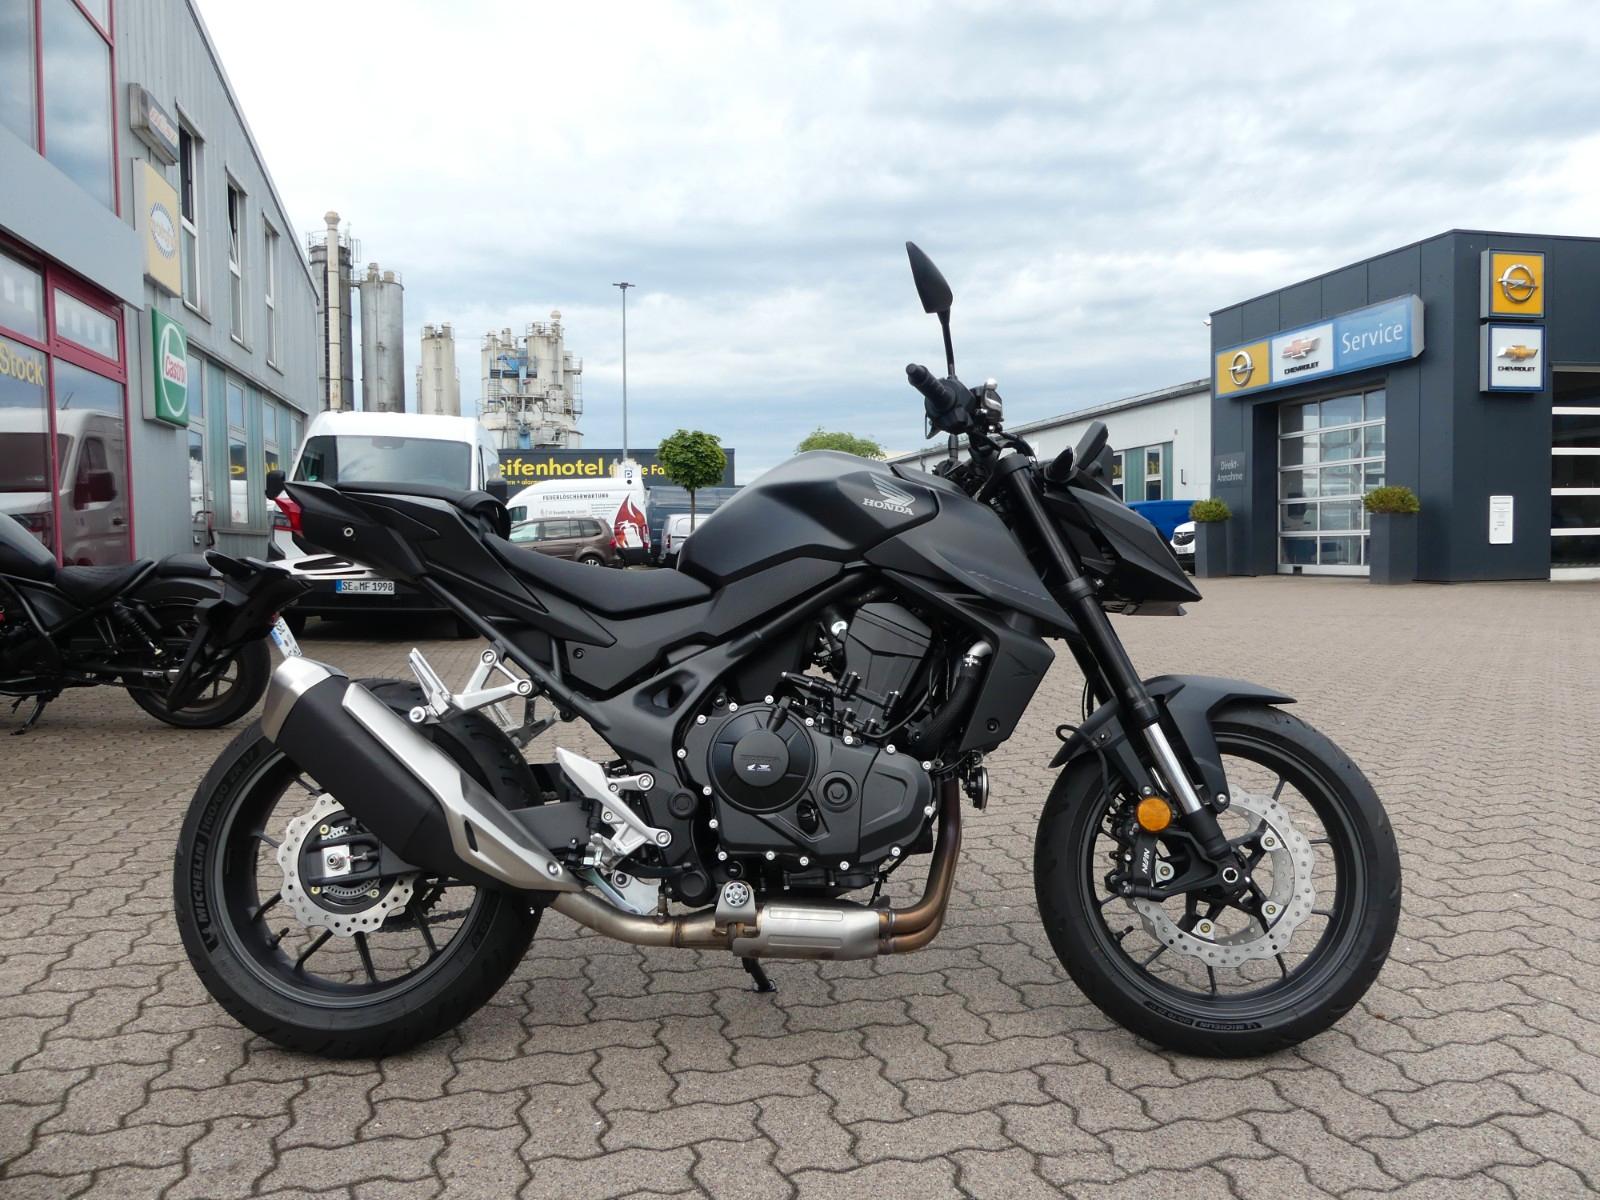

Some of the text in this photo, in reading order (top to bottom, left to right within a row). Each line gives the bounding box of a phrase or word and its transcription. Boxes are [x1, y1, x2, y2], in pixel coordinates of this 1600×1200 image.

[1341, 322, 1403, 354] Service
[0, 342, 44, 386] Stock
[1284, 361, 1319, 375] CHEVROLET
[499, 458, 603, 476] eifenhotel
[862, 498, 914, 516] HONDA
[343, 582, 353, 591] SE
[372, 583, 393, 592] 1998
[192, 841, 209, 923] MICHELIN
